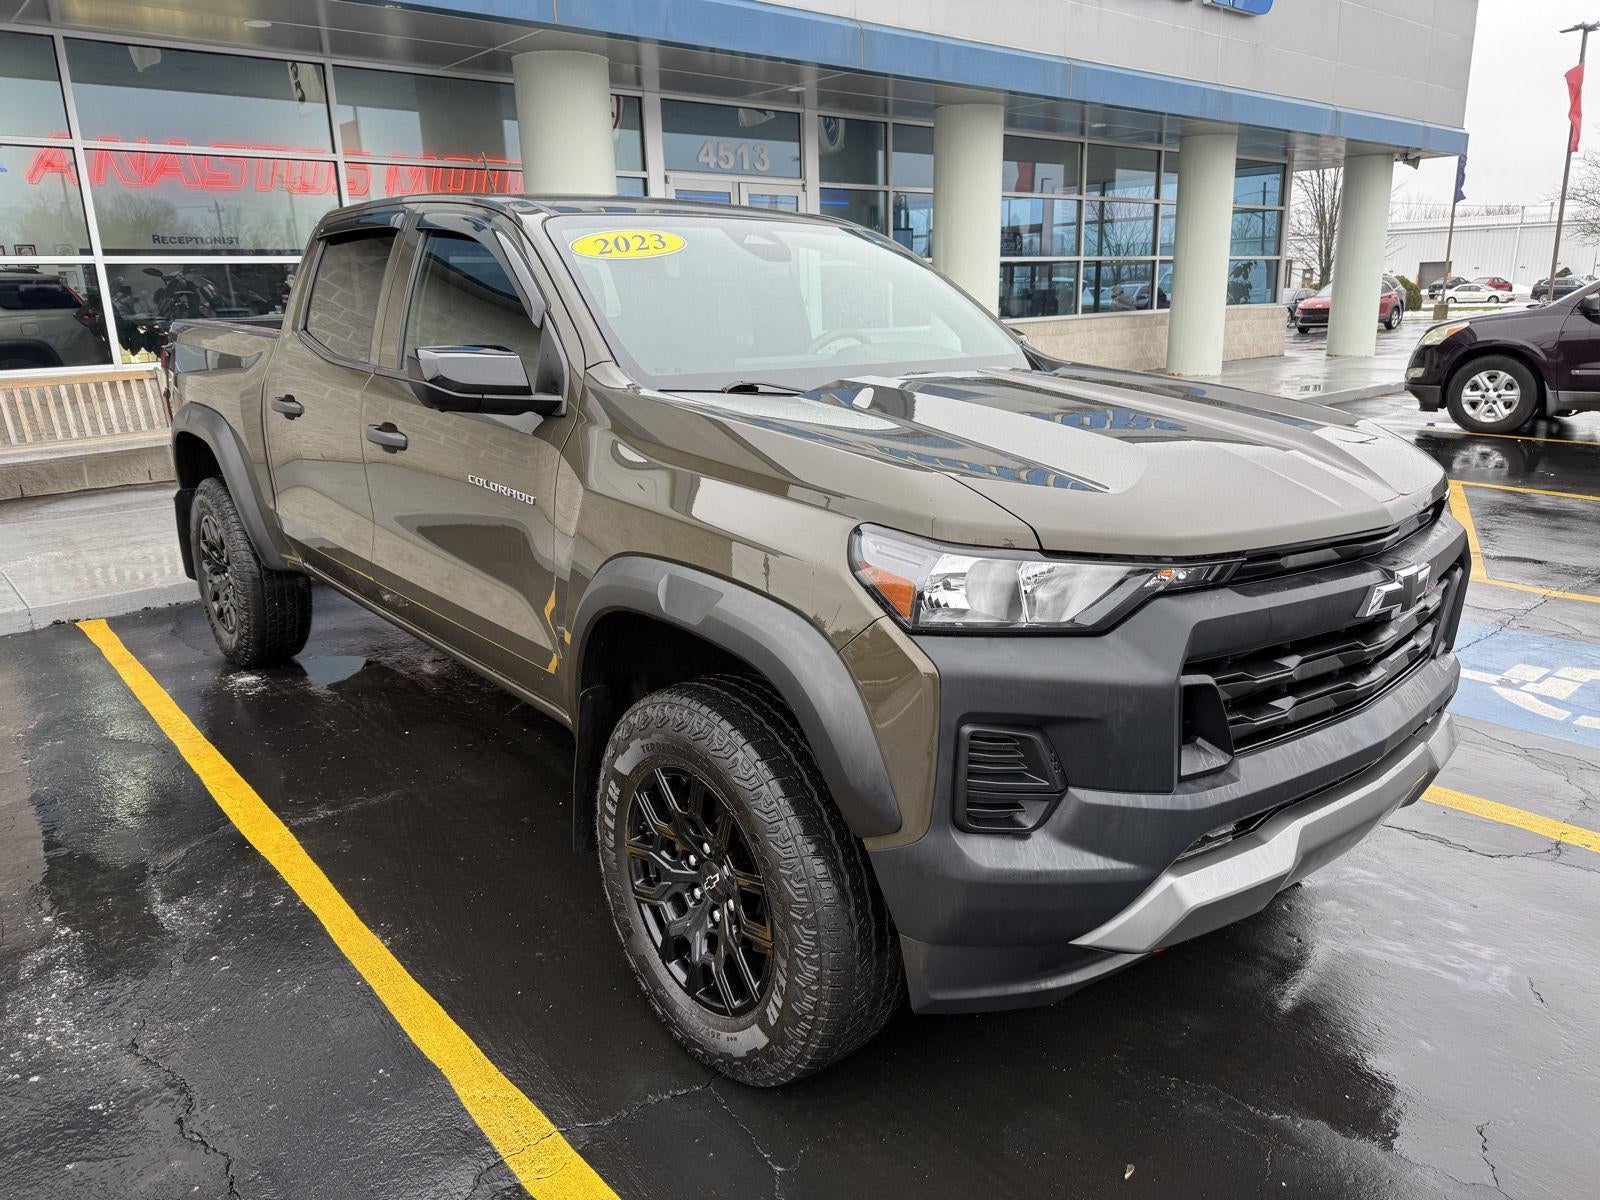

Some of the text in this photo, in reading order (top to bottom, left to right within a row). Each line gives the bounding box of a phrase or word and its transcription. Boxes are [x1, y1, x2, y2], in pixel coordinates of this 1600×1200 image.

[25, 134, 371, 195] ANASTOS
[697, 139, 770, 172] 4513
[594, 233, 667, 255] 2023
[468, 474, 535, 505] COLORADO
